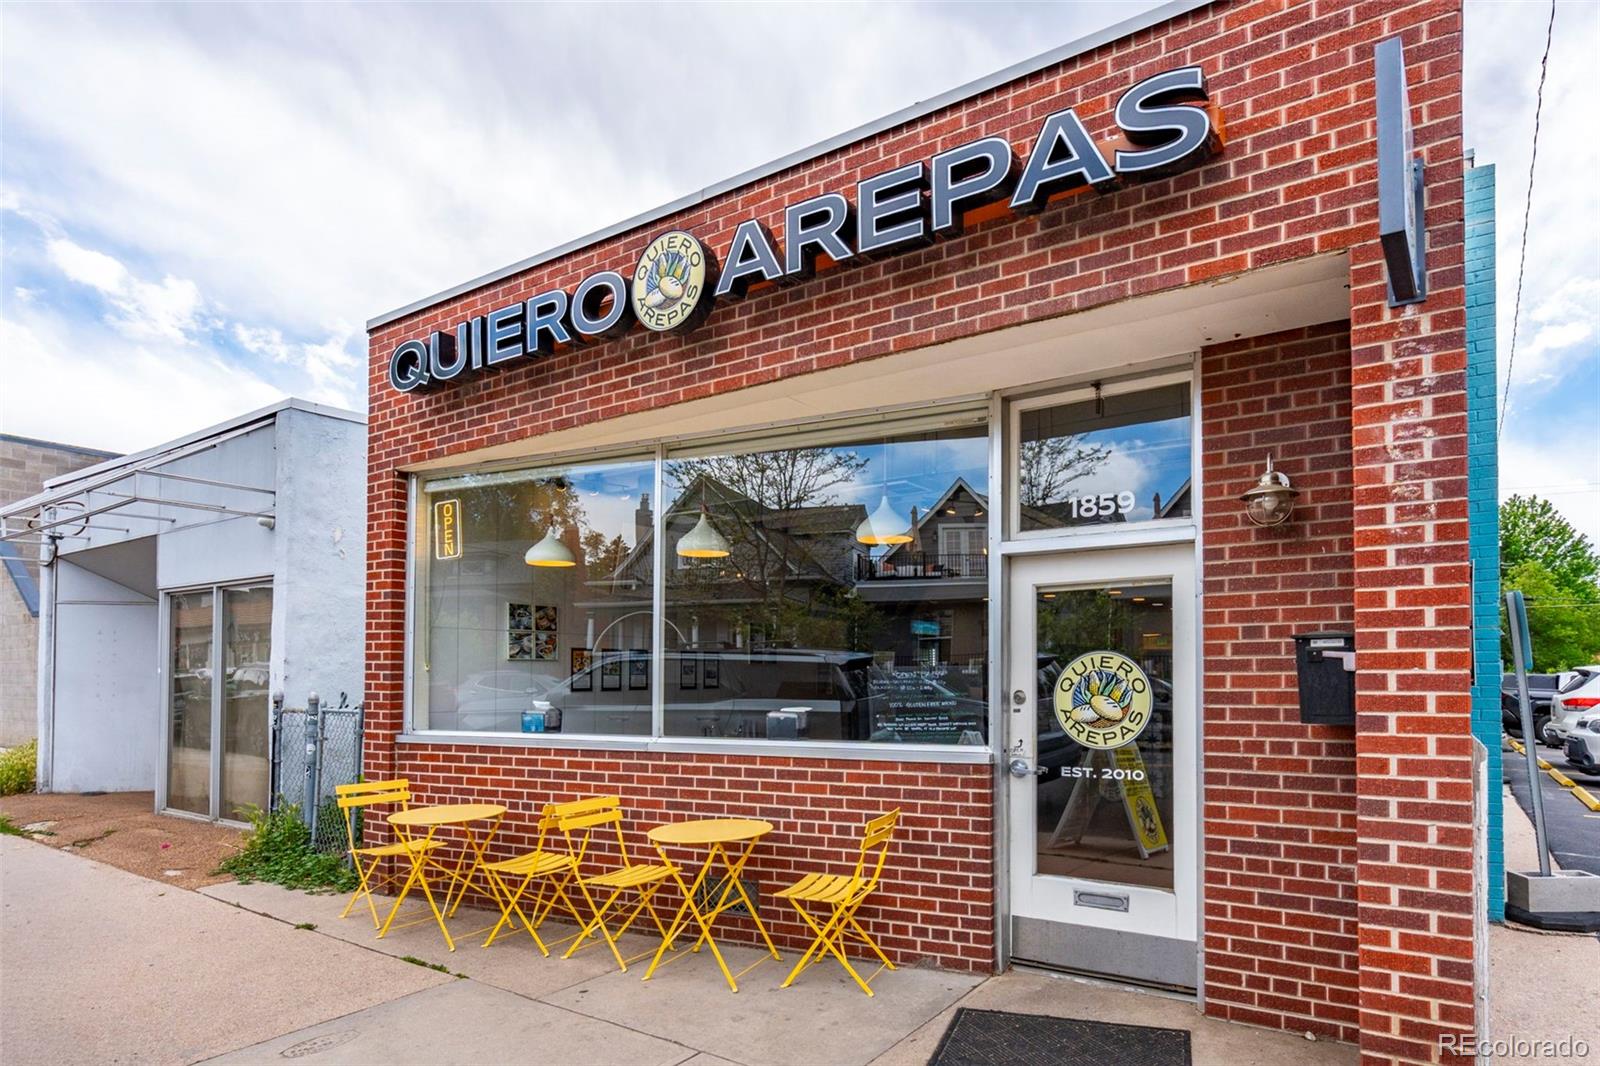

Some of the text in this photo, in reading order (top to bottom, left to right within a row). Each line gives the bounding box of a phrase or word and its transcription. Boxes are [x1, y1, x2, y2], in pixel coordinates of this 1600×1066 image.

[388, 66, 1211, 393] QUIERO AREPAS
[638, 236, 701, 281] QUIERO
[637, 285, 698, 326] AREPAS
[1068, 490, 1136, 518] 1859
[443, 504, 454, 556] OPEN
[1060, 656, 1146, 694] QUIERO
[1060, 708, 1143, 745] AREPAS
[1060, 766, 1145, 781] EST. 2010
